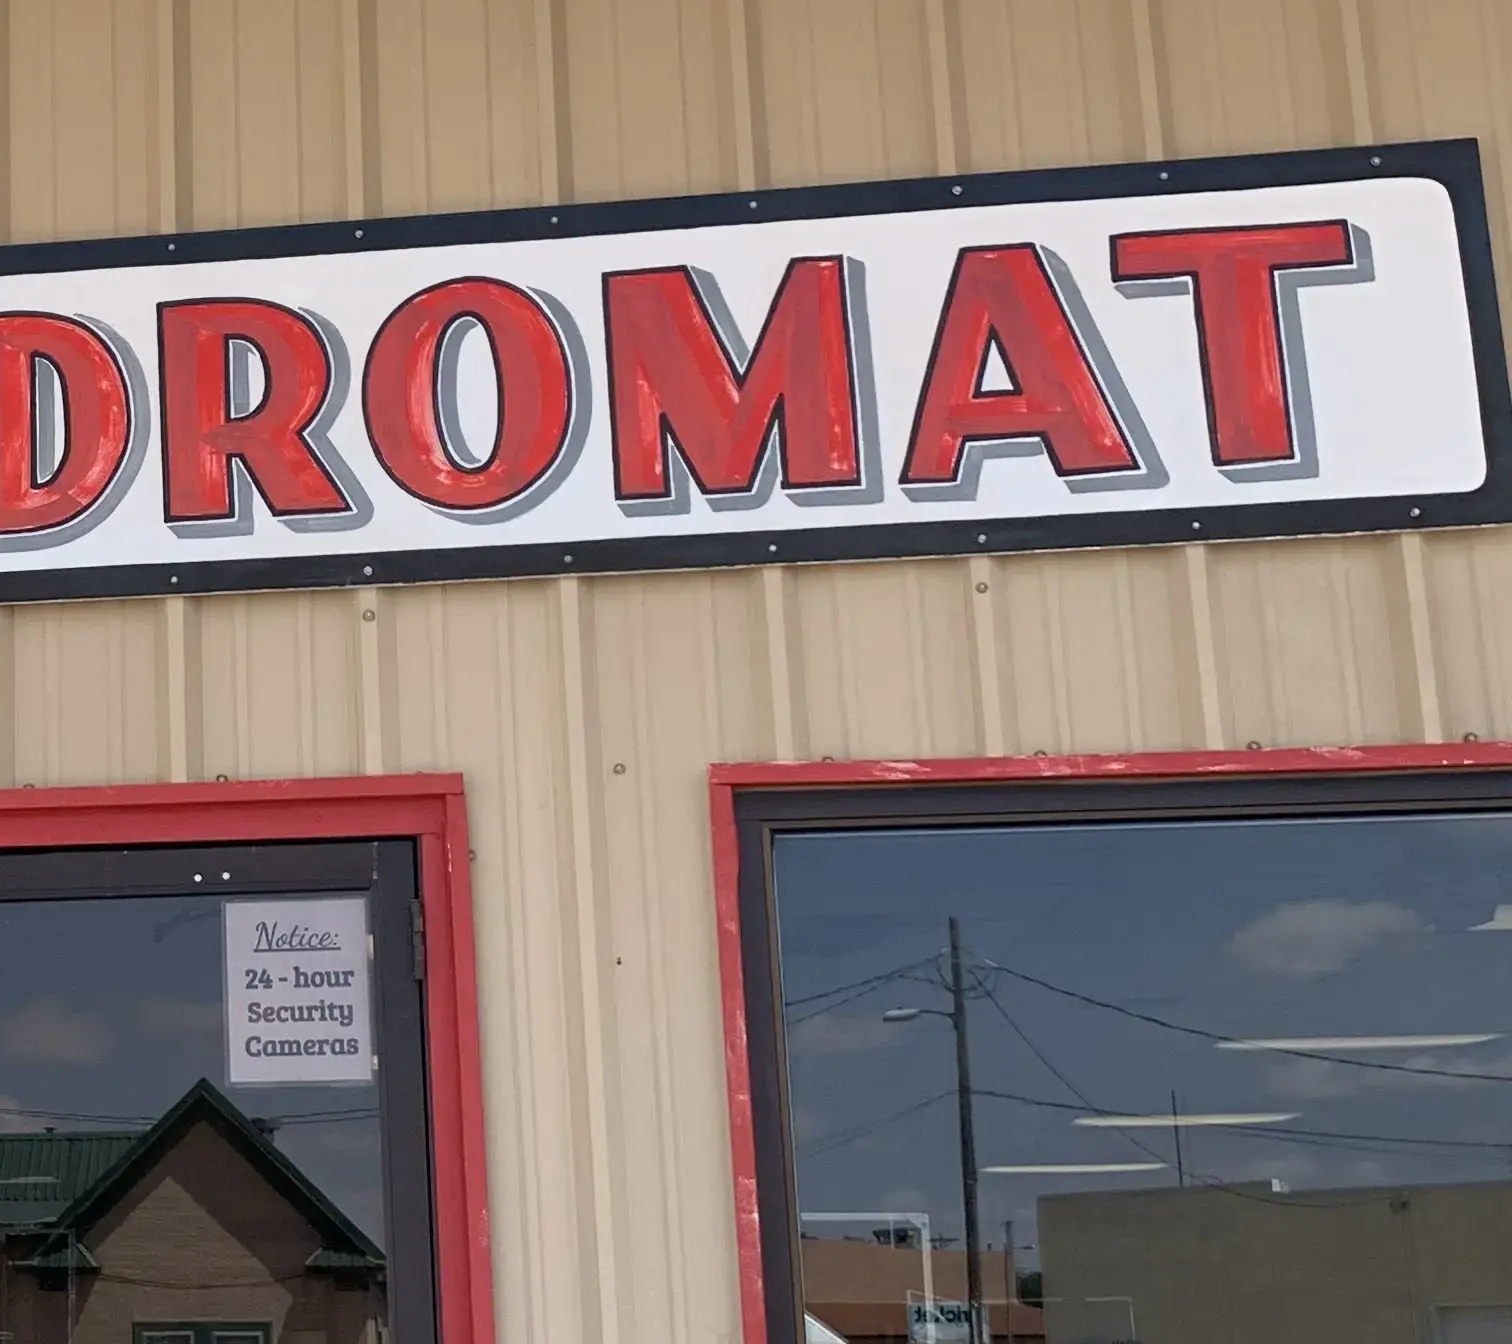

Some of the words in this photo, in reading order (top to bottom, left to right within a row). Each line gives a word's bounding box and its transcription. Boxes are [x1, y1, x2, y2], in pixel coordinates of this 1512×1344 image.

[254, 920, 340, 952] Notice:
[246, 999, 354, 1027] Security
[244, 1035, 360, 1058] Cameras
